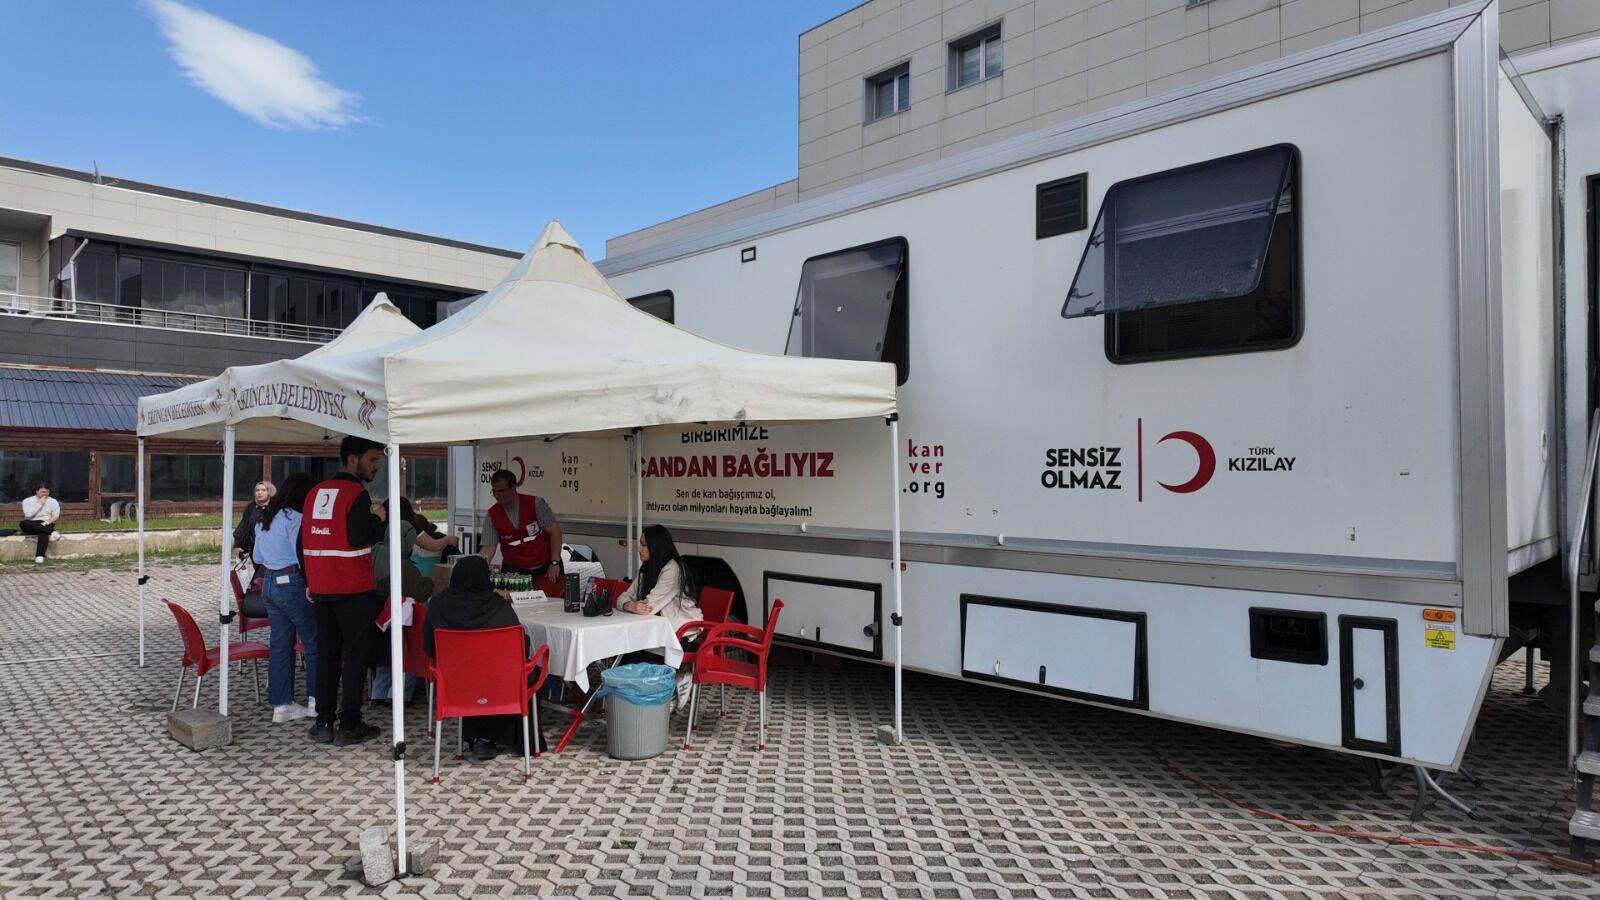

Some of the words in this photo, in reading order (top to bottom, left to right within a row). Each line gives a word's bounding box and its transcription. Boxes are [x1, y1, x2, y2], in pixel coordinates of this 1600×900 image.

[908, 439, 944, 457] kan
[1249, 446, 1275, 456] TÜRK
[561, 452, 579, 464] kan
[722, 447, 834, 477] BAĞLIYIZ
[1228, 457, 1296, 471] KIZILAY
[562, 466, 578, 475] ver
[908, 462, 942, 474] ver
[560, 480, 579, 491] .org
[1040, 470, 1121, 489] OLMAZ
[676, 488, 689, 498] Sen
[691, 488, 701, 499] de
[702, 488, 717, 498] kan
[718, 488, 763, 501] bağışçımız
[764, 488, 776, 501] ol,
[903, 482, 945, 499] .org
[672, 502, 689, 512] olan
[689, 502, 728, 514] milyonları
[729, 503, 758, 515] hayata
[759, 504, 812, 517] bağlayalım!
